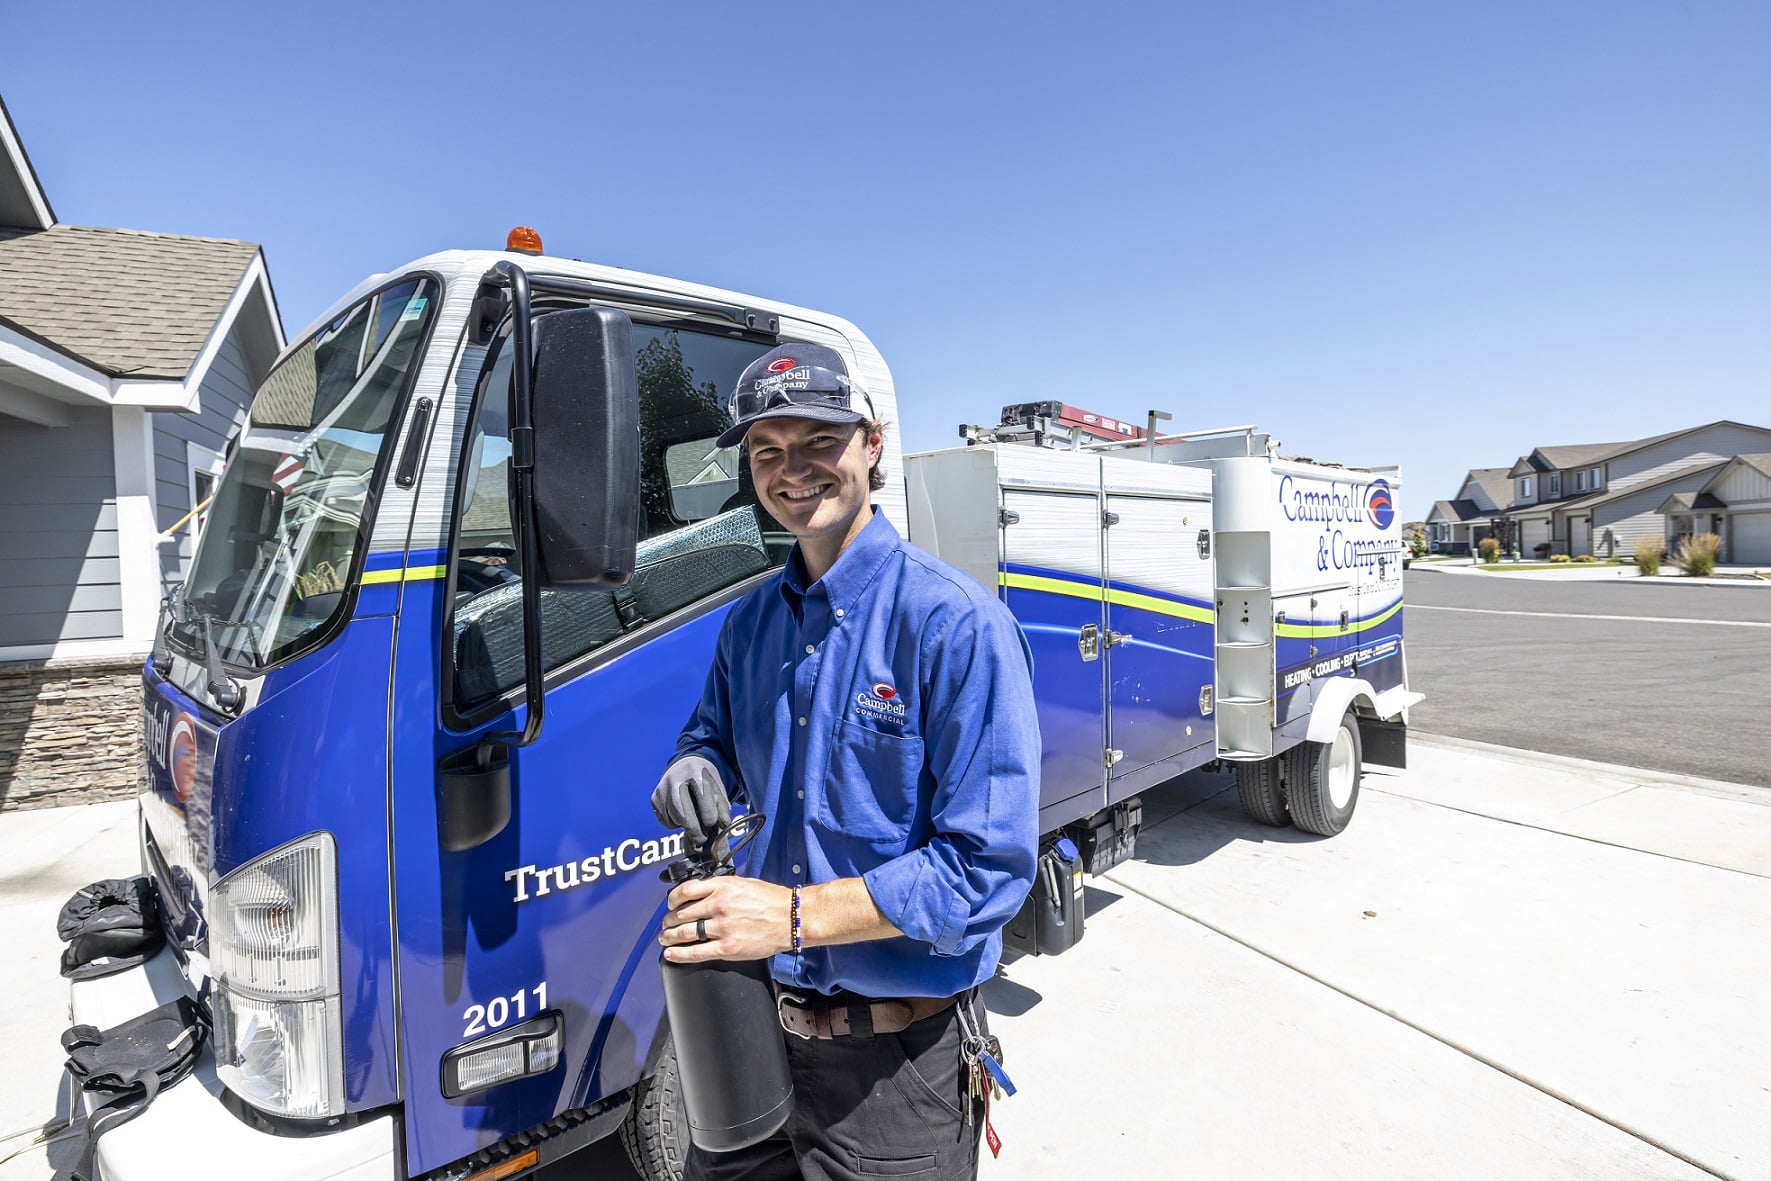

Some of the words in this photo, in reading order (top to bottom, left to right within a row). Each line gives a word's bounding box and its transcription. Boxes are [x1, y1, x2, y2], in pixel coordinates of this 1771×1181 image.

[1279, 474, 1363, 532] Campbell
[1317, 535, 1329, 572] &
[1284, 667, 1312, 689] HEATING
[1315, 657, 1341, 677] COOLING
[855, 707, 905, 725] COMMERCIAL
[857, 692, 905, 716] Campbell
[463, 981, 548, 1038] 2011
